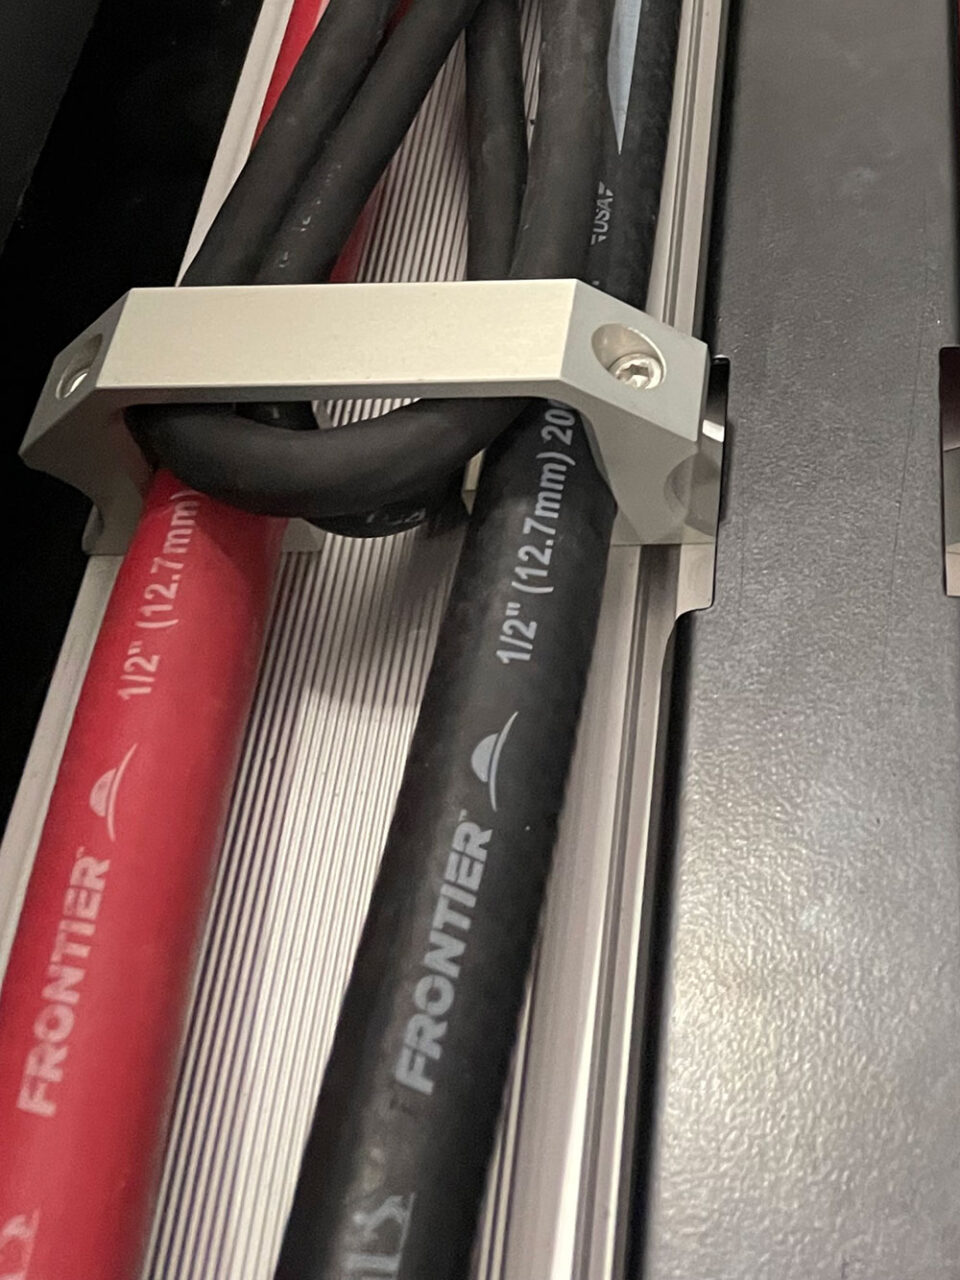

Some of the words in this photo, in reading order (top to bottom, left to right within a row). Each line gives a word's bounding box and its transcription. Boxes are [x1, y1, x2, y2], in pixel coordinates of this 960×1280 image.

[134, 489, 202, 629] (12.7mm)
[511, 451, 576, 594] (12.7mm)
[117, 639, 161, 702] 1/2"
[496, 601, 538, 664] 1/2"
[16, 854, 112, 1118] FRONTIER
[395, 820, 494, 1096] FRONTIER
